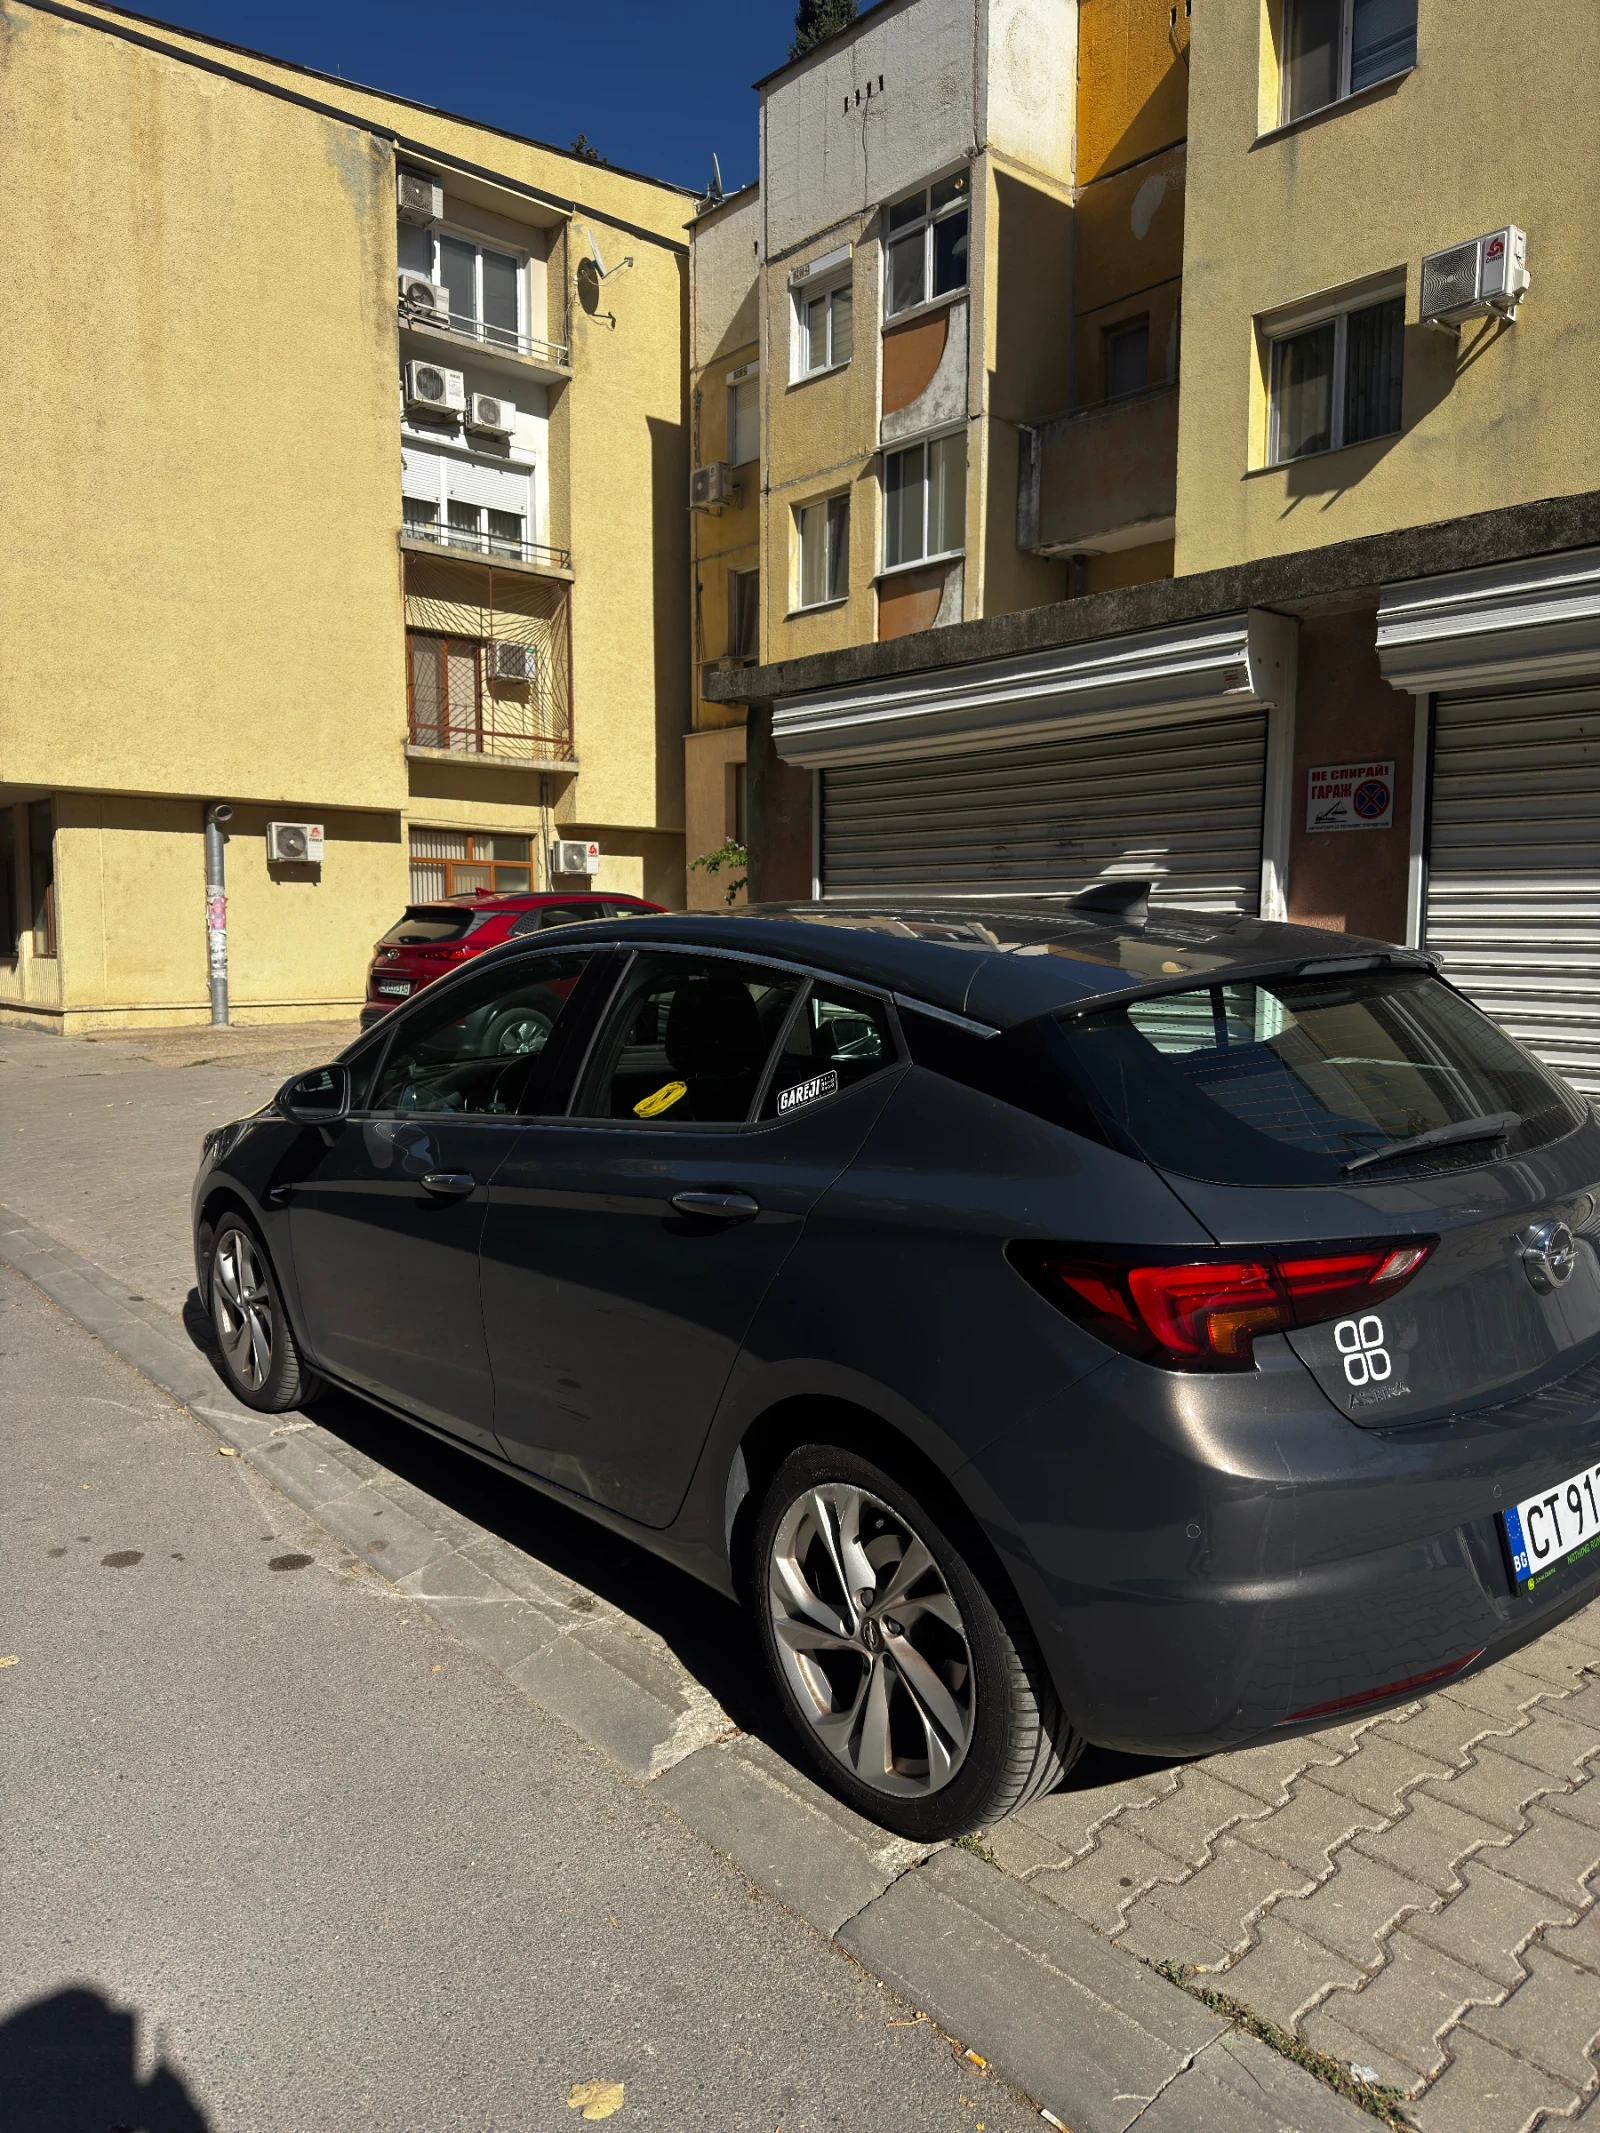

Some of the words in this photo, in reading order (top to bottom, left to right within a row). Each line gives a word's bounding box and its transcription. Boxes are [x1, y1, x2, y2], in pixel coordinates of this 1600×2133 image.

[1312, 771, 1327, 782] НЕ
[1331, 764, 1389, 780] СПИРАЙ!
[1311, 783, 1352, 799] ГАРАЖ
[1567, 1467, 1600, 1535] 91
[1514, 1551, 1528, 1572] BG
[1567, 1543, 1590, 1565] NOTHING
